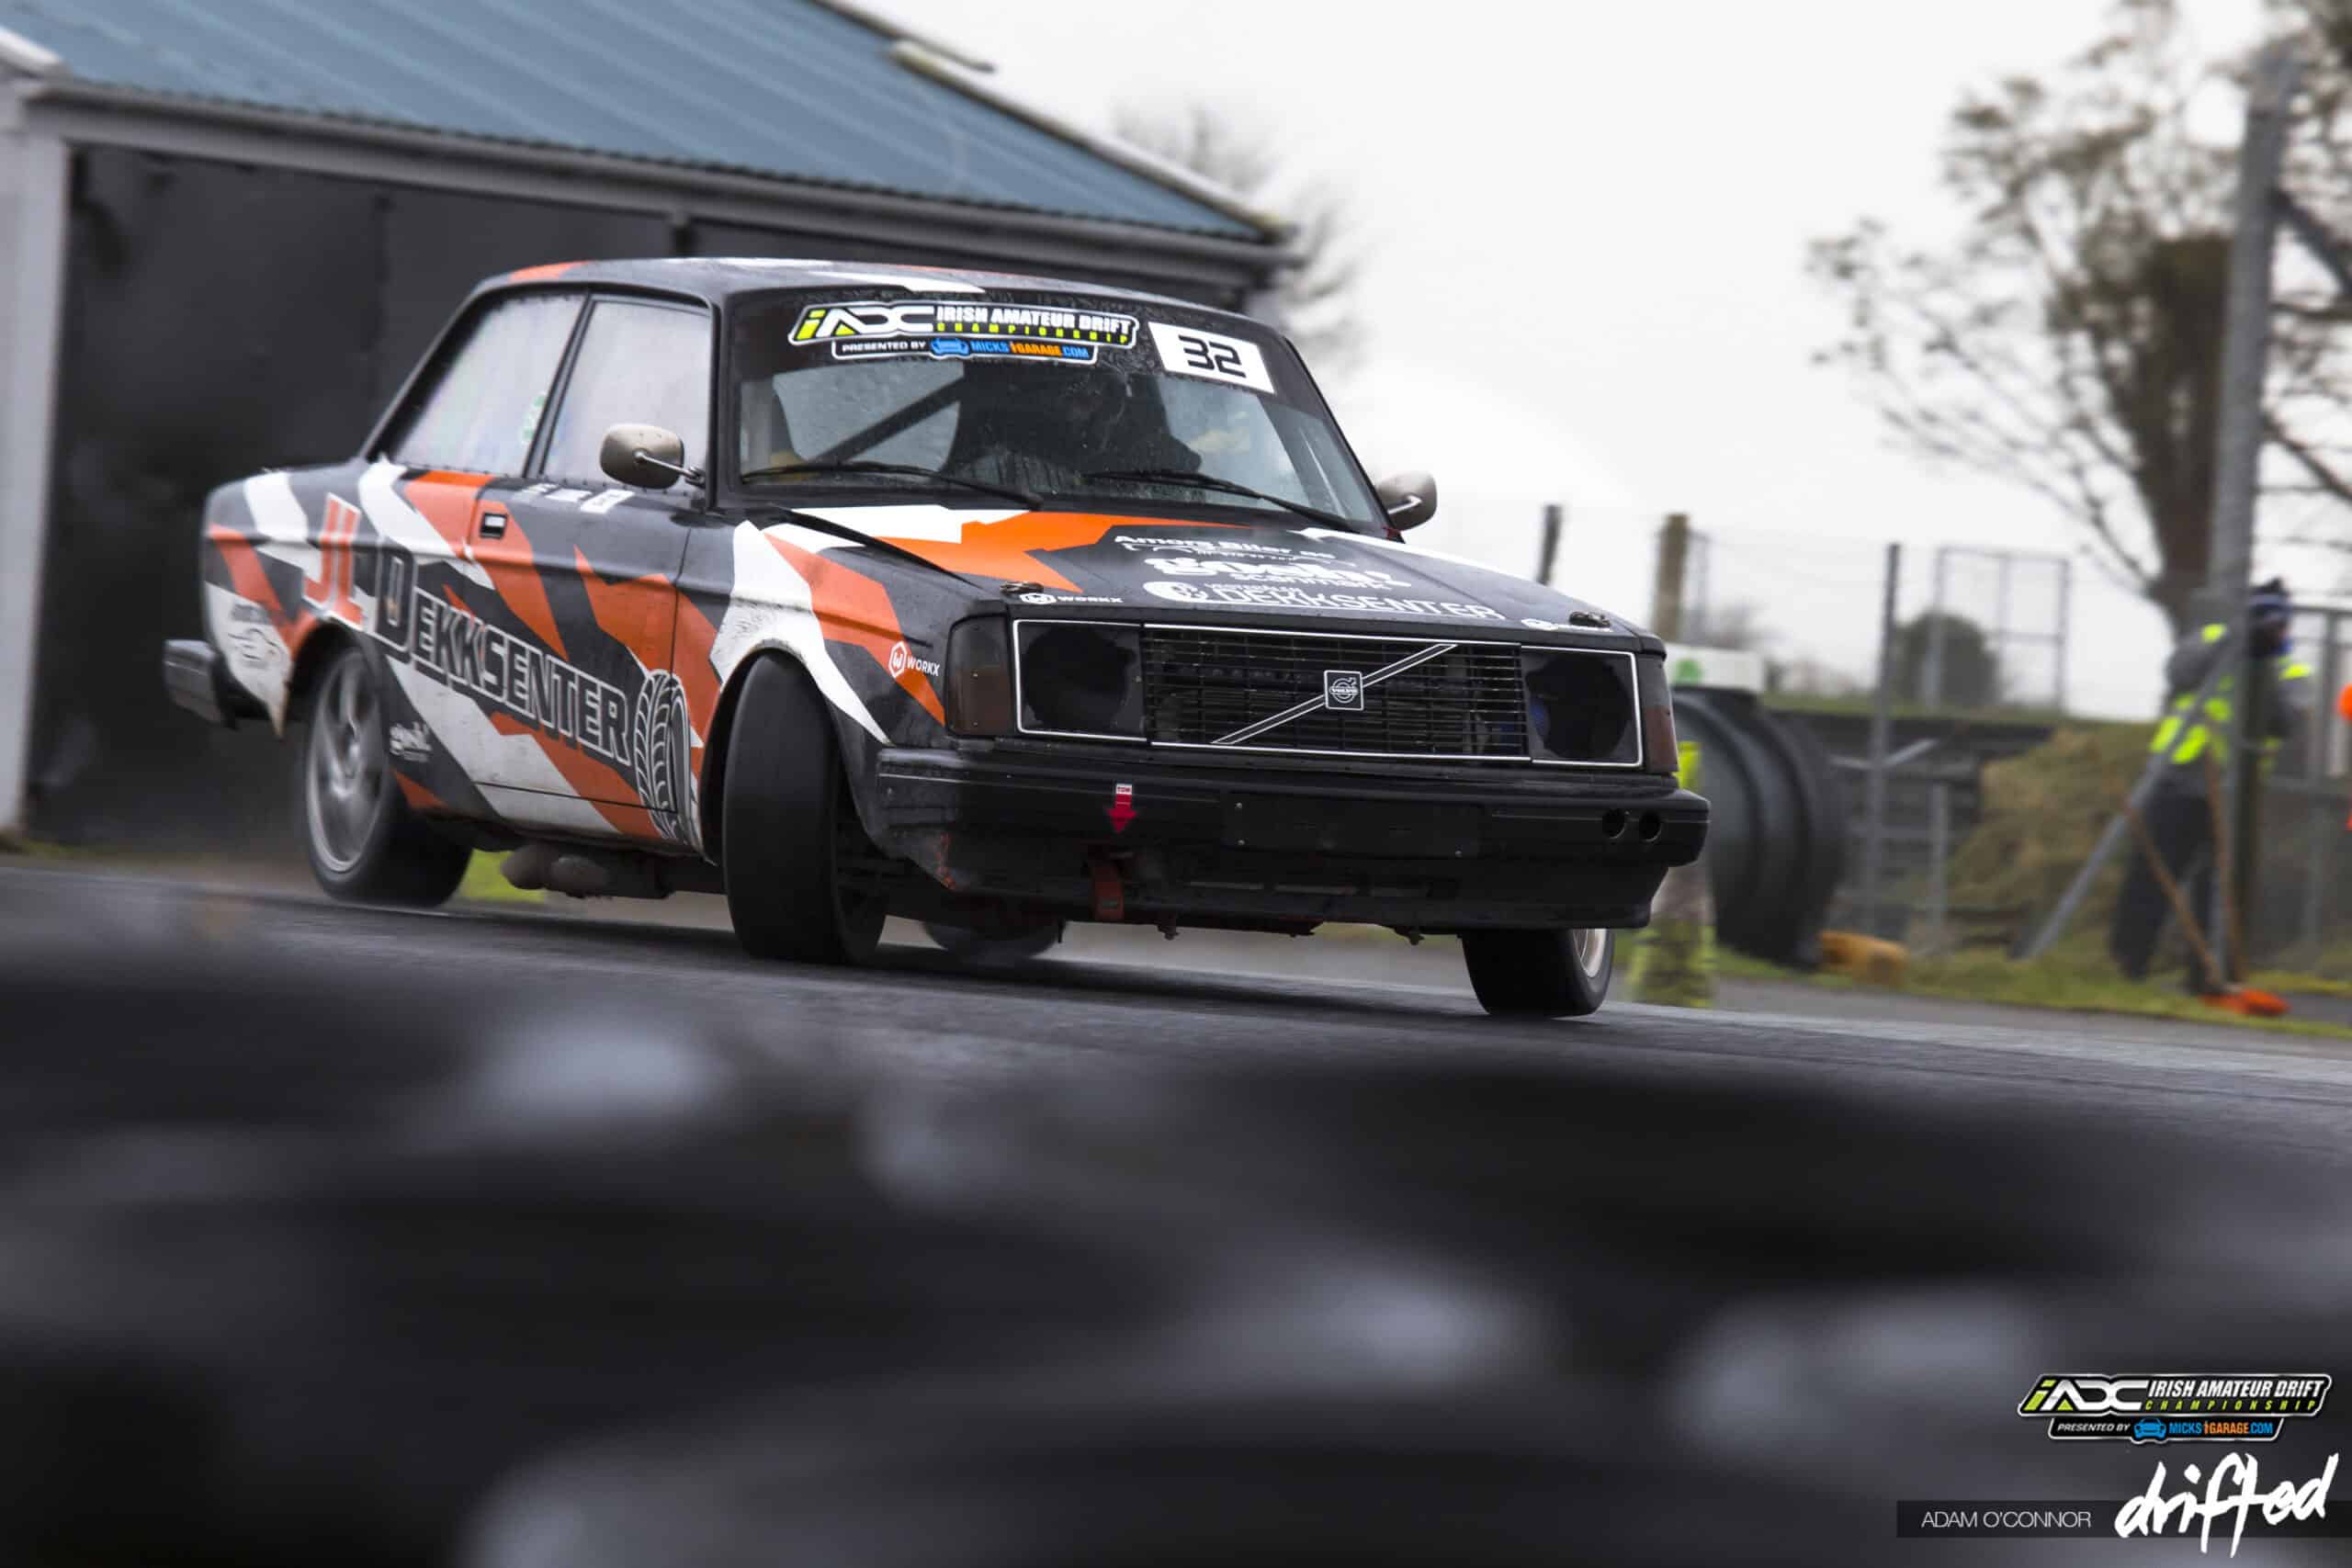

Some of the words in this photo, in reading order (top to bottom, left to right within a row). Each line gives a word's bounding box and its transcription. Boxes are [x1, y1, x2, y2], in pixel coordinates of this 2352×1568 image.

[935, 306, 989, 322] IRISH
[990, 309, 1075, 328] AMATEUR
[1079, 316, 1131, 334] DRIFT
[842, 342, 908, 354] PRESENTED
[910, 341, 927, 349] BY
[1178, 334, 1247, 378] 32
[1208, 584, 1507, 620] DEKKSENTER
[907, 655, 941, 676] WORKX
